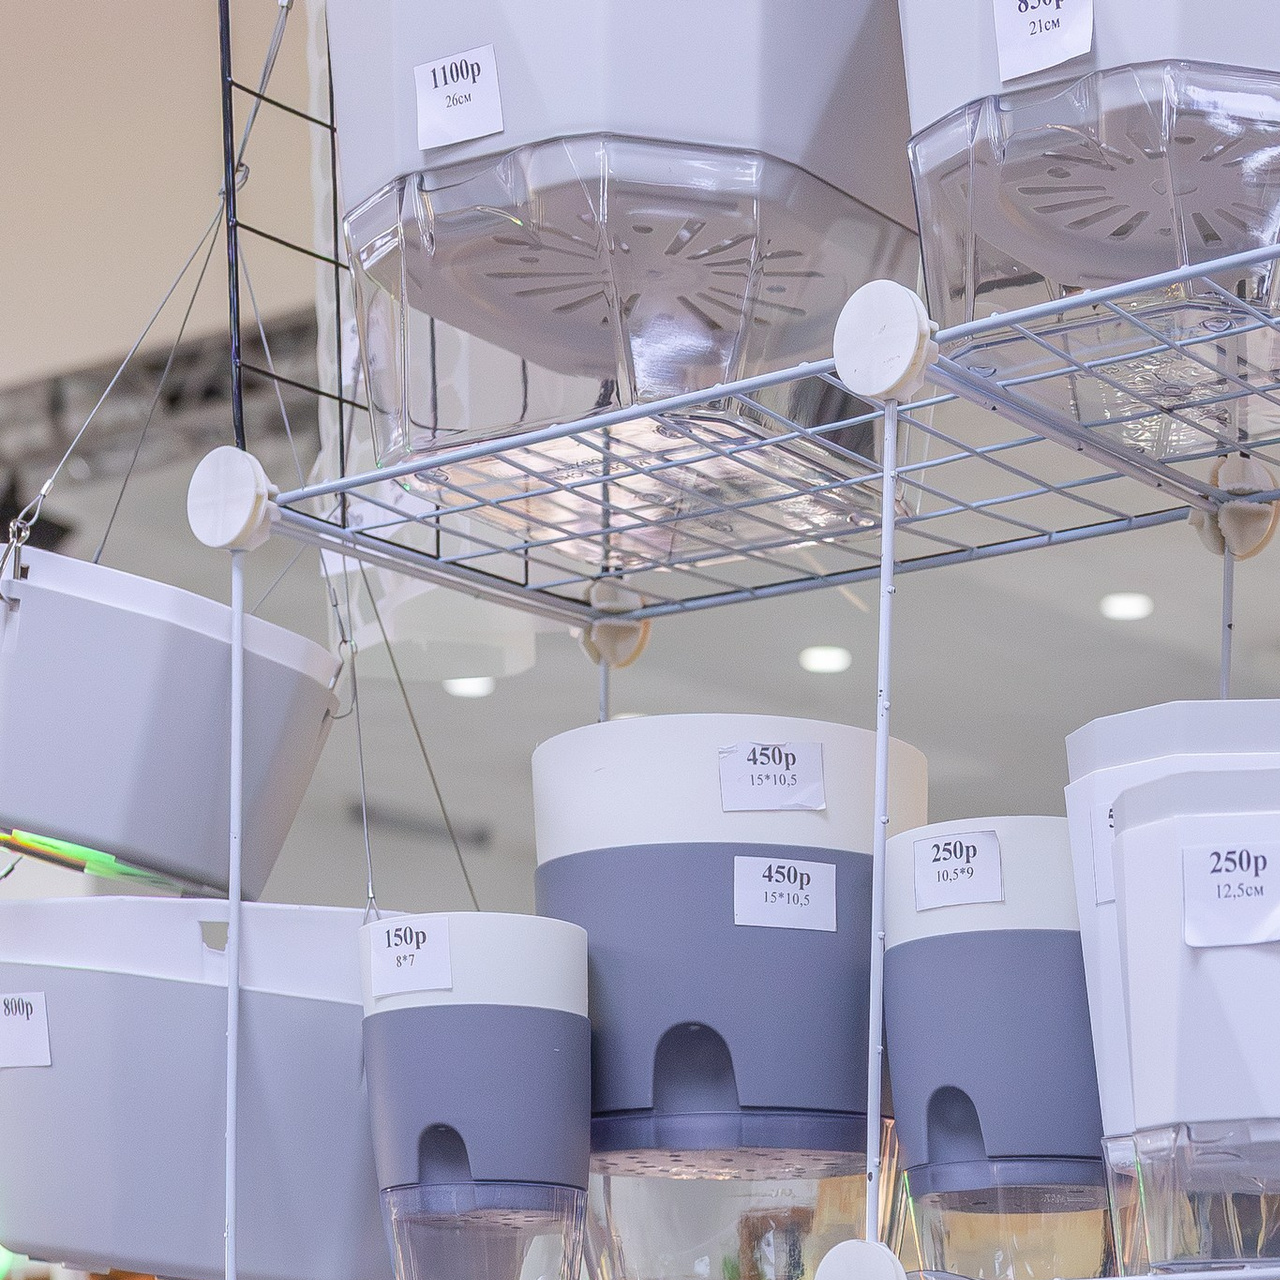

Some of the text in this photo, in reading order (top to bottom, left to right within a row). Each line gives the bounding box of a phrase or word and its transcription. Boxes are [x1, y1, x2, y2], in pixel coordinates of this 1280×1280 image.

[1029, 17, 1060, 36] 21см
[430, 59, 482, 90] 1100р
[446, 93, 473, 108] 26см
[746, 747, 797, 771] 450р
[931, 840, 978, 864] 250р
[1209, 849, 1267, 877] 250р
[762, 865, 811, 890] 450р
[1216, 884, 1264, 899] 12,5см
[385, 926, 428, 950] 150р
[3, 997, 33, 1020] 800р
